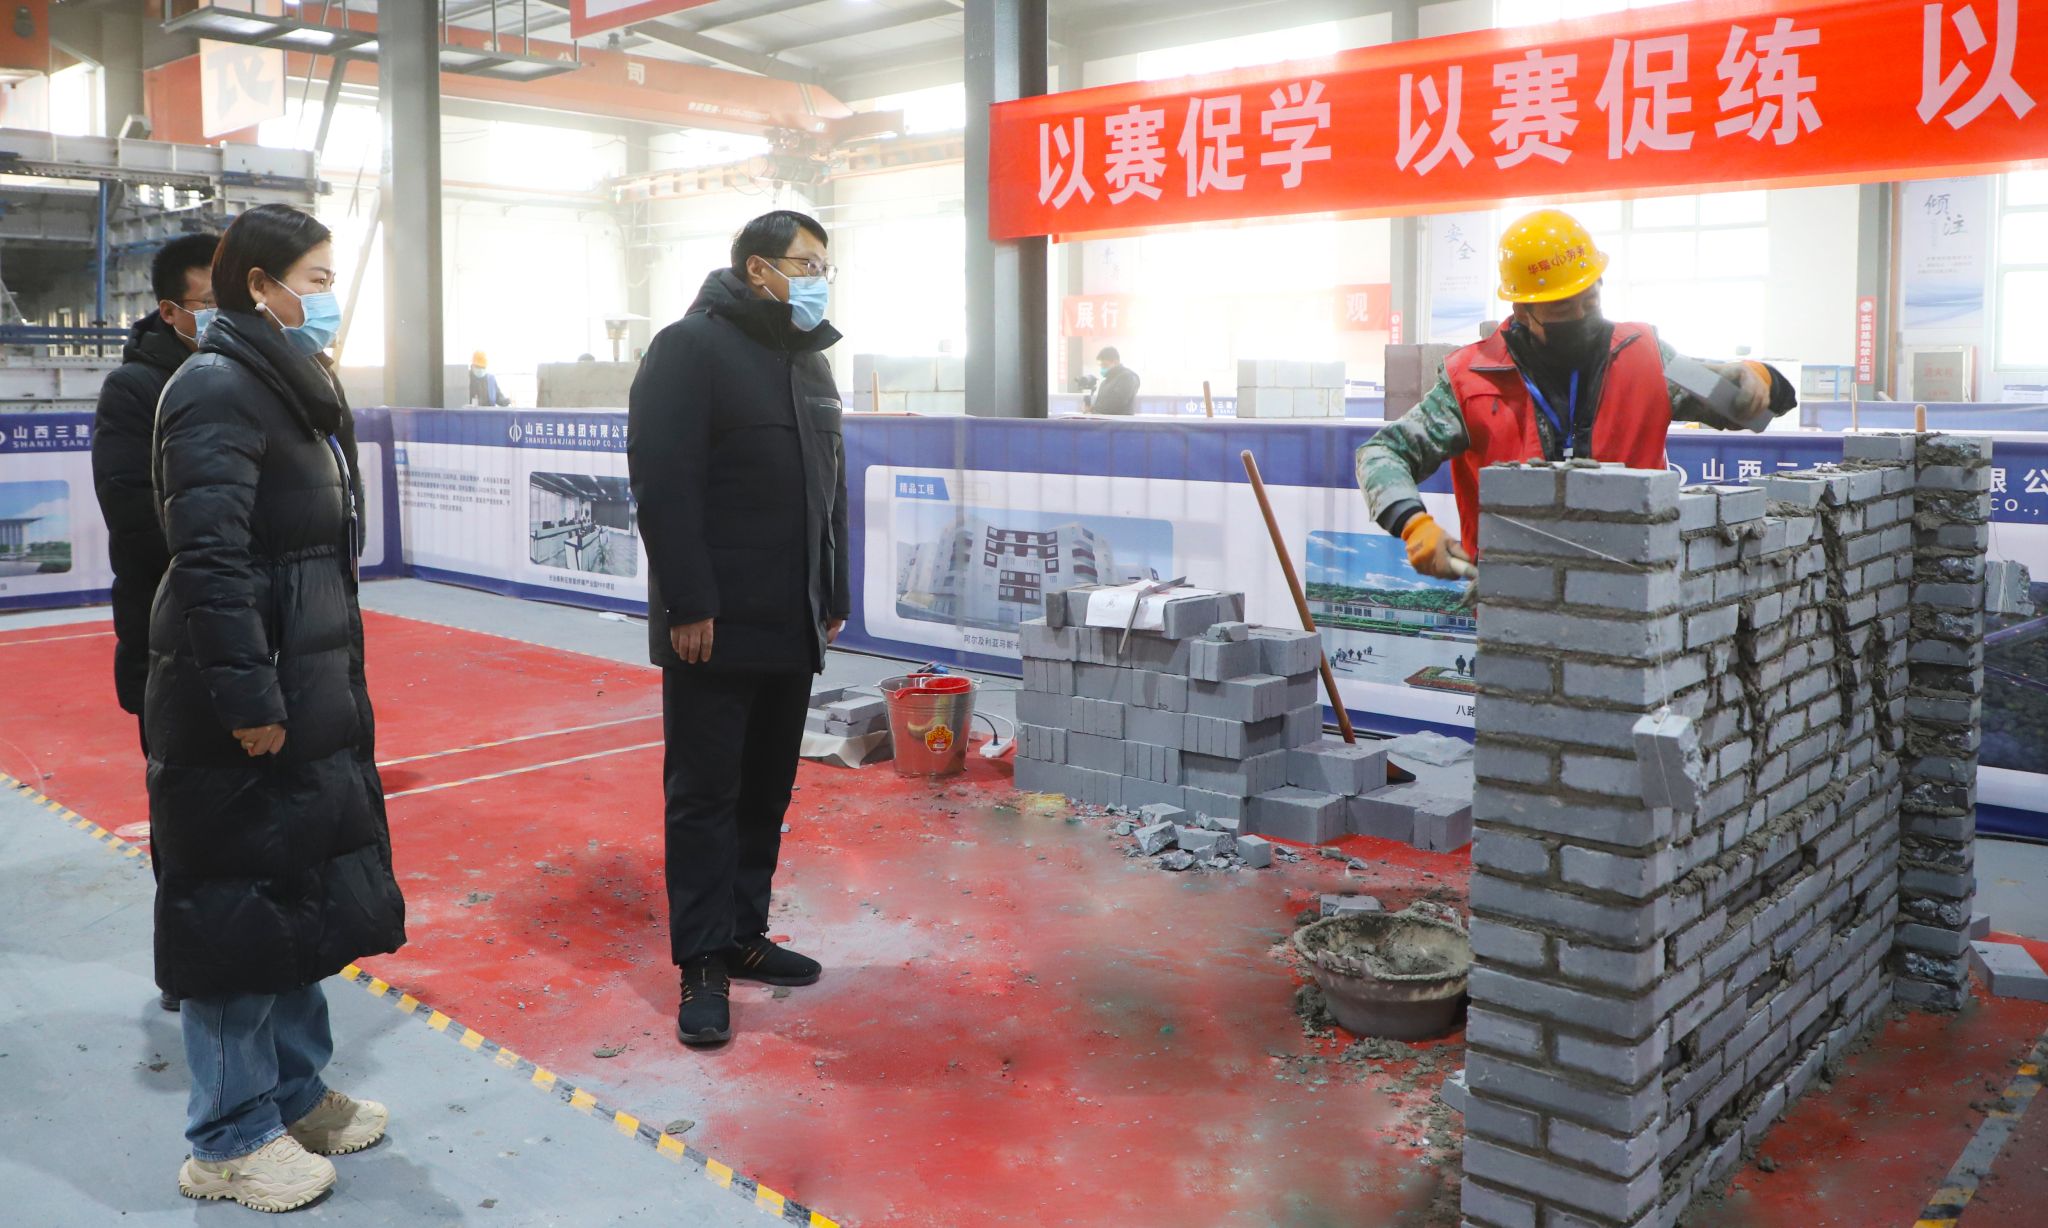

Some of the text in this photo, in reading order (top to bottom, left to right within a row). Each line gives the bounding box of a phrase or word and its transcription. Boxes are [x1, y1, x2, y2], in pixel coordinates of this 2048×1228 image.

[1038, 0, 2037, 210] 以赛促学 以赛促练 以
[13, 424, 90, 439] 山西三建
[13, 440, 57, 449] SHANXI
[578, 438, 600, 447] GROUP
[900, 482, 935, 495] 精品工程
